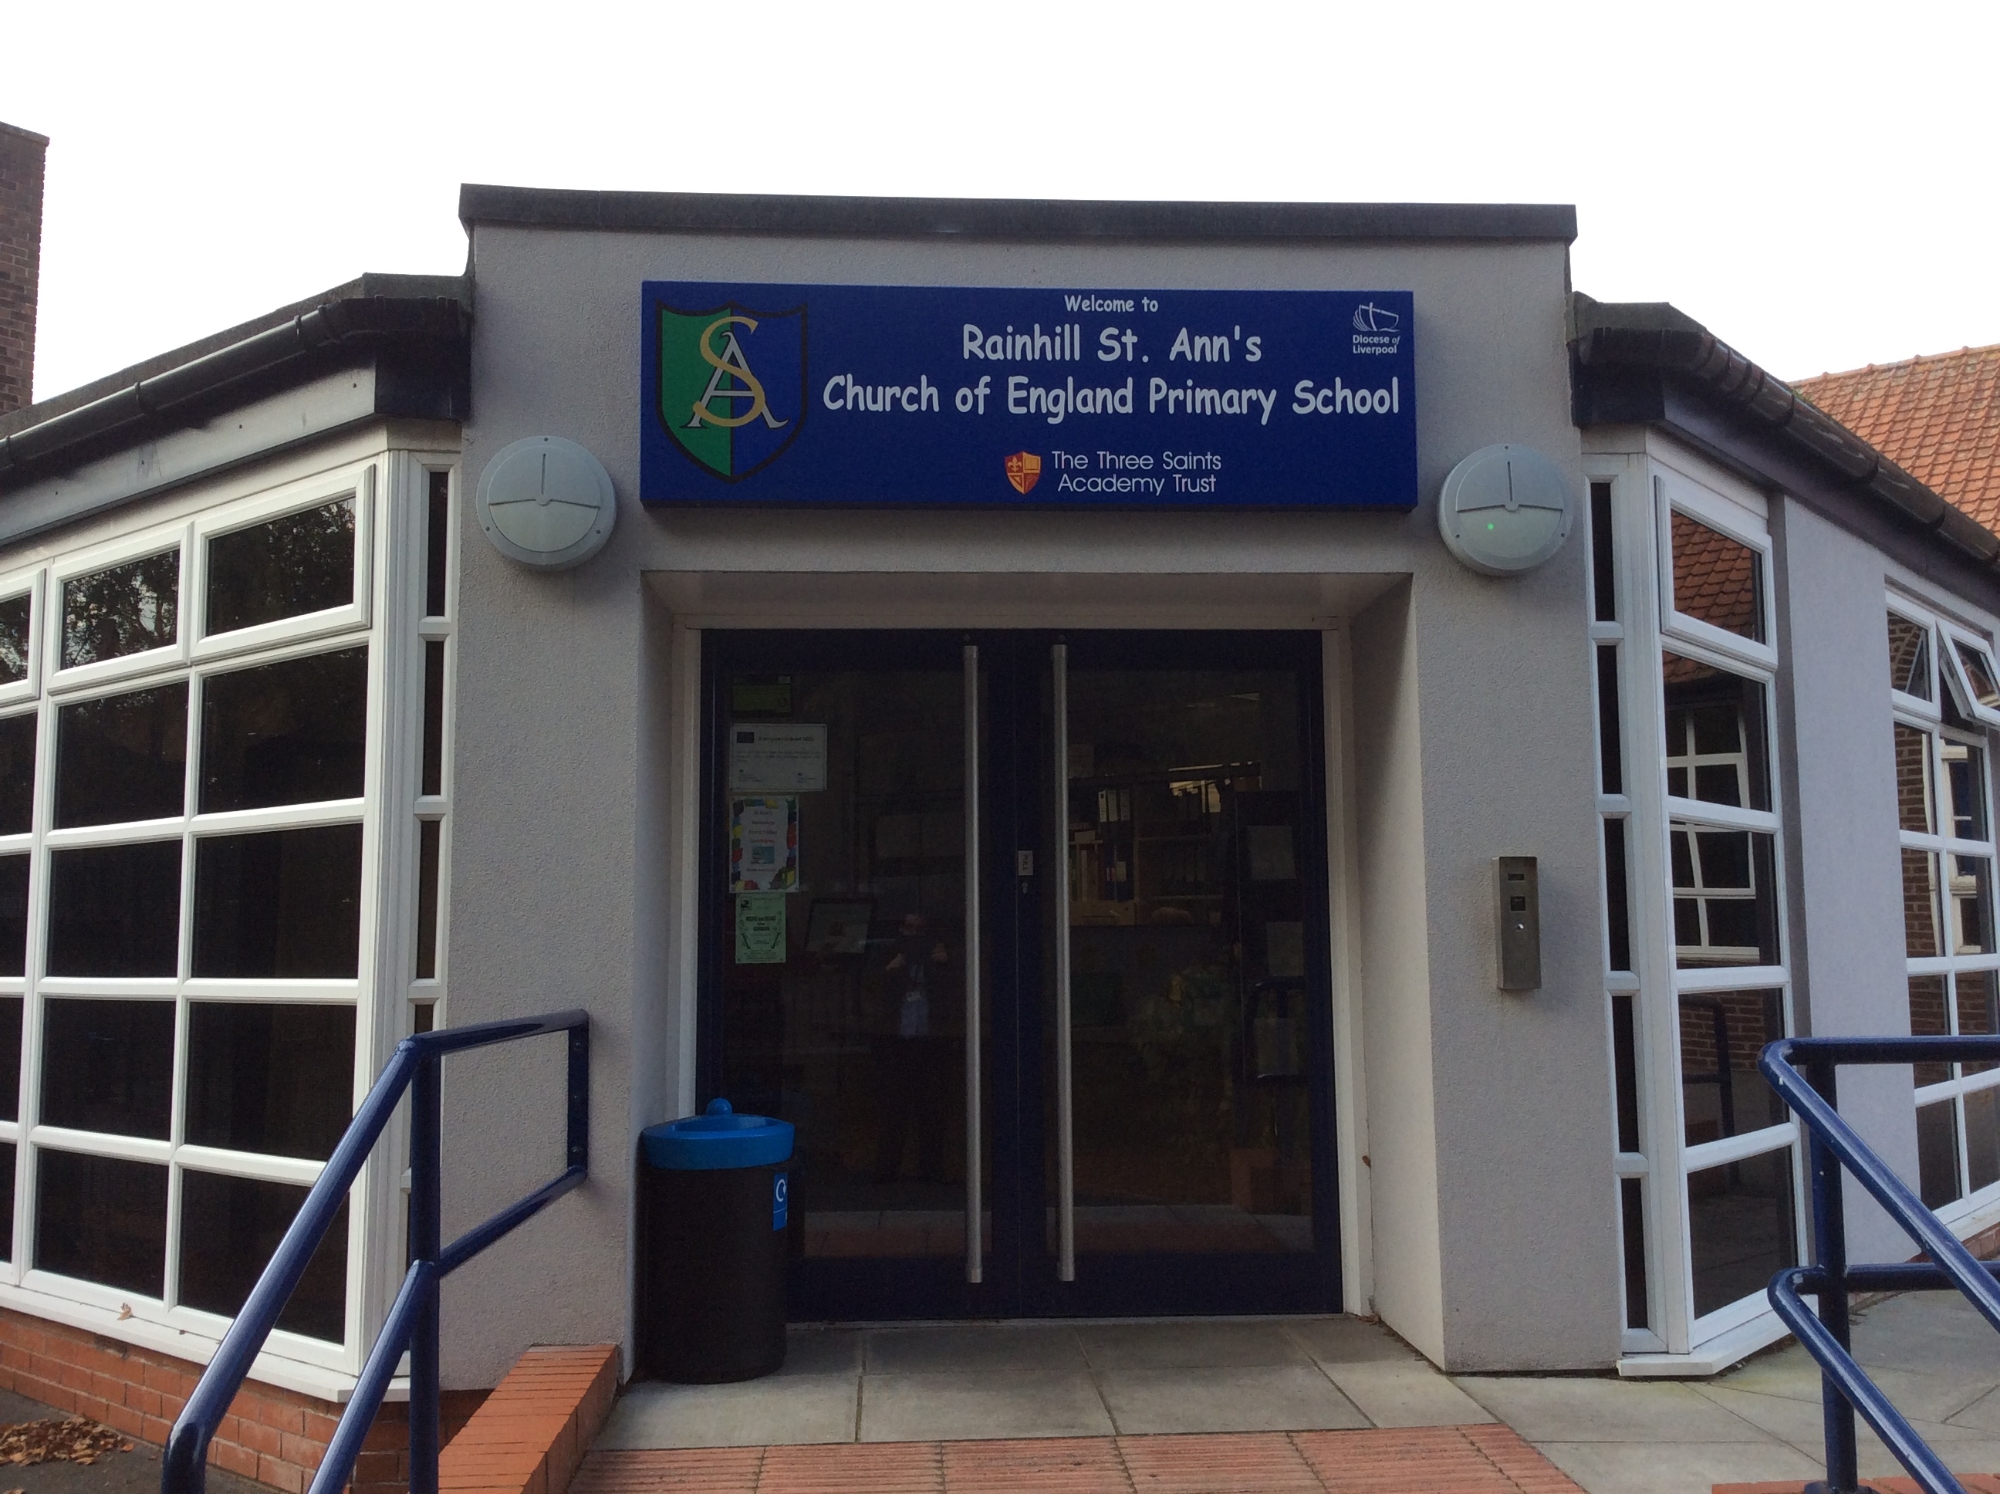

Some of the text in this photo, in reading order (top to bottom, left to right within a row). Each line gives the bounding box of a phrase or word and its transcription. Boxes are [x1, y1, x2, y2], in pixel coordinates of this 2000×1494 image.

[1064, 294, 1159, 313] Welcome to
[963, 323, 1262, 363] Rainhill St. Ann's
[1352, 334, 1401, 346] Diocese of
[1352, 344, 1397, 356] Liverpool
[823, 373, 1399, 426] Church of England Primary School
[1051, 450, 1222, 470] The Three Saints
[1057, 473, 1217, 496] Academy Trust
